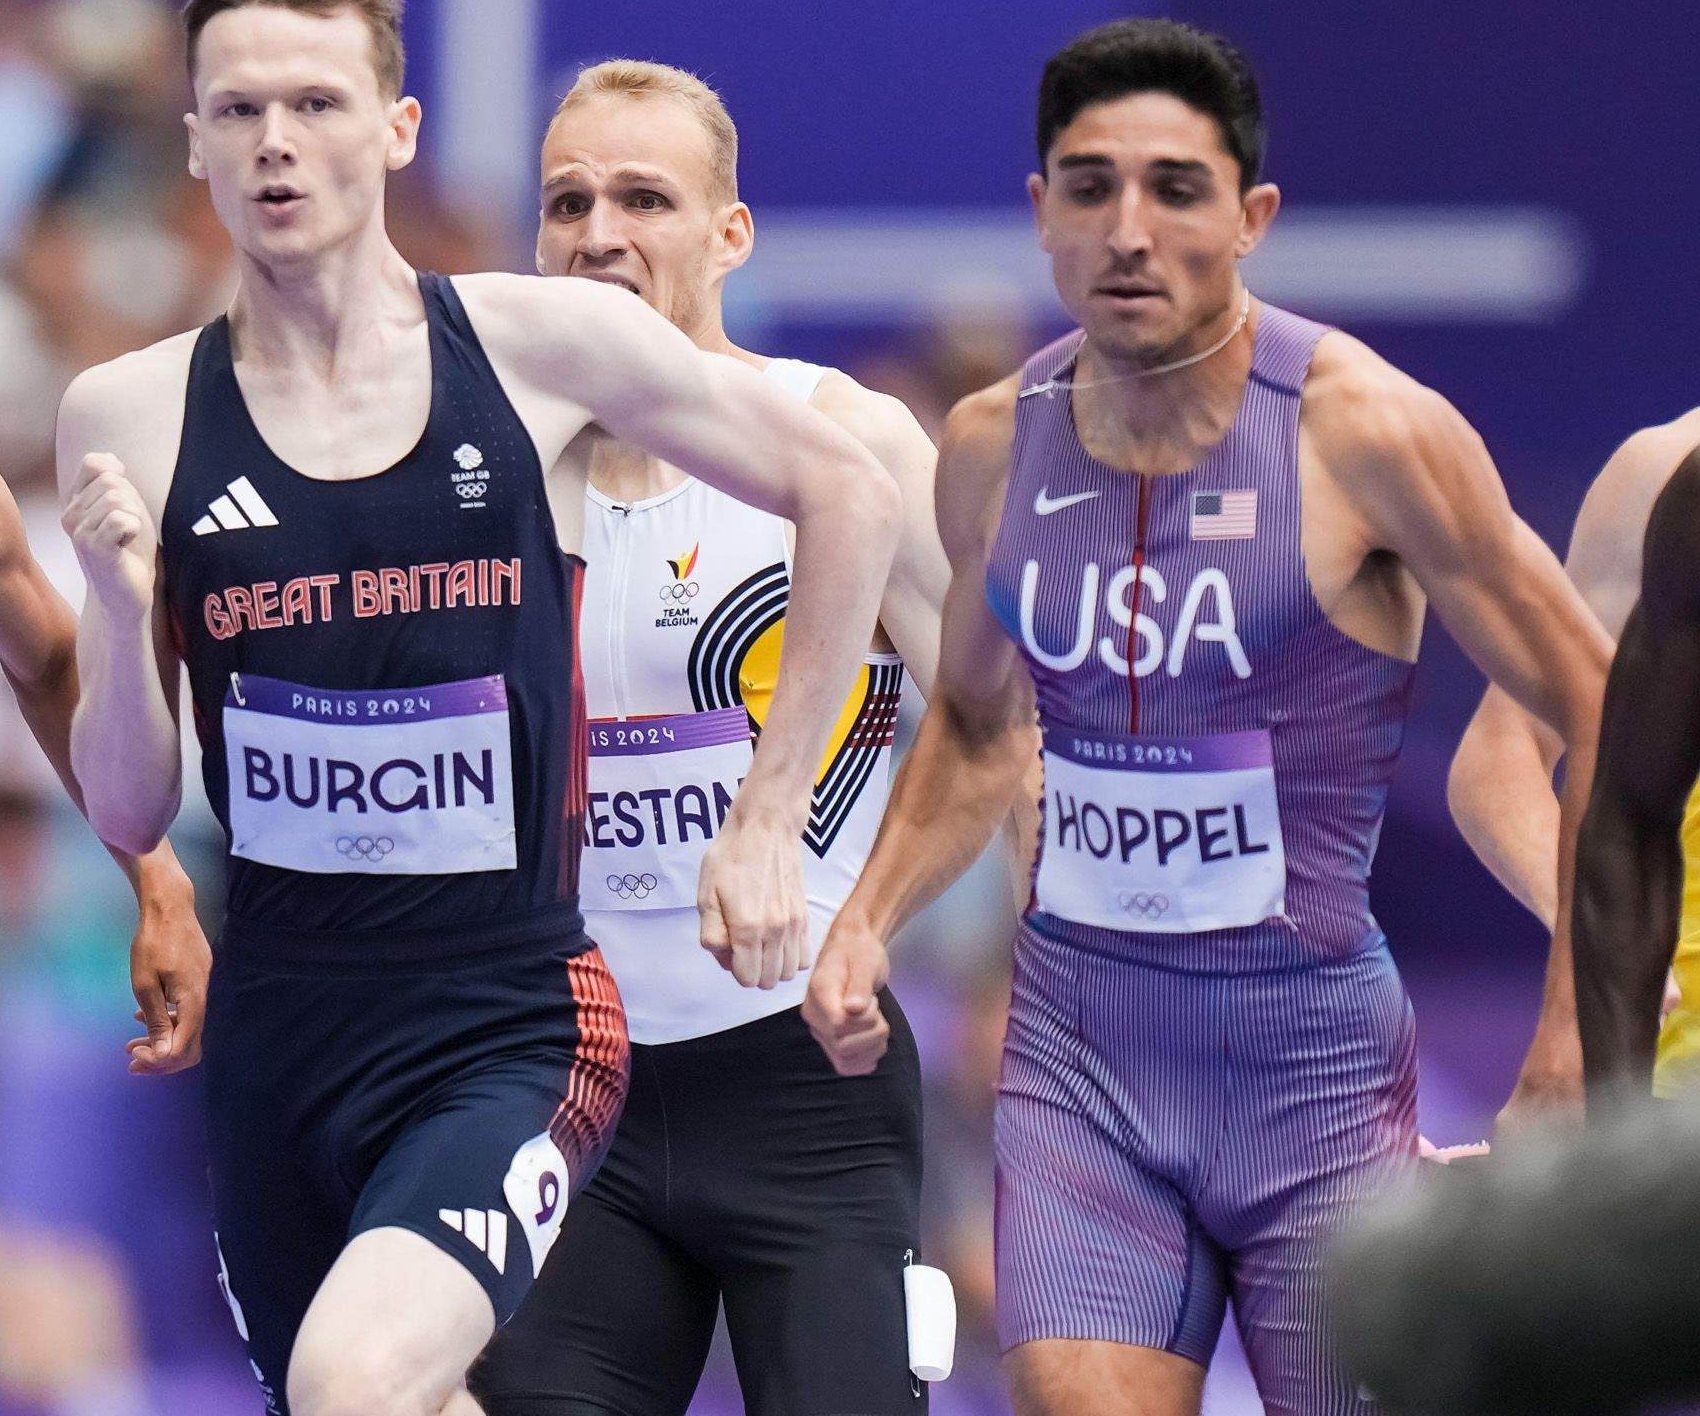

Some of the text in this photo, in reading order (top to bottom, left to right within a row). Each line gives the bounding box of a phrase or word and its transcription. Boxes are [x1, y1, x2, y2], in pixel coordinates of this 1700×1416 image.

[203, 557, 522, 641] GREAT BRITAIN
[663, 607, 690, 618] TEAM
[1020, 558, 1252, 679] USA
[655, 617, 698, 628] BELGIUM
[366, 699, 431, 717] 2024
[616, 726, 676, 746] 2024
[1133, 744, 1193, 765] 2024
[243, 749, 495, 814] BURGIN
[1056, 789, 1270, 867] HOPPEL
[534, 1170, 560, 1227] 9
